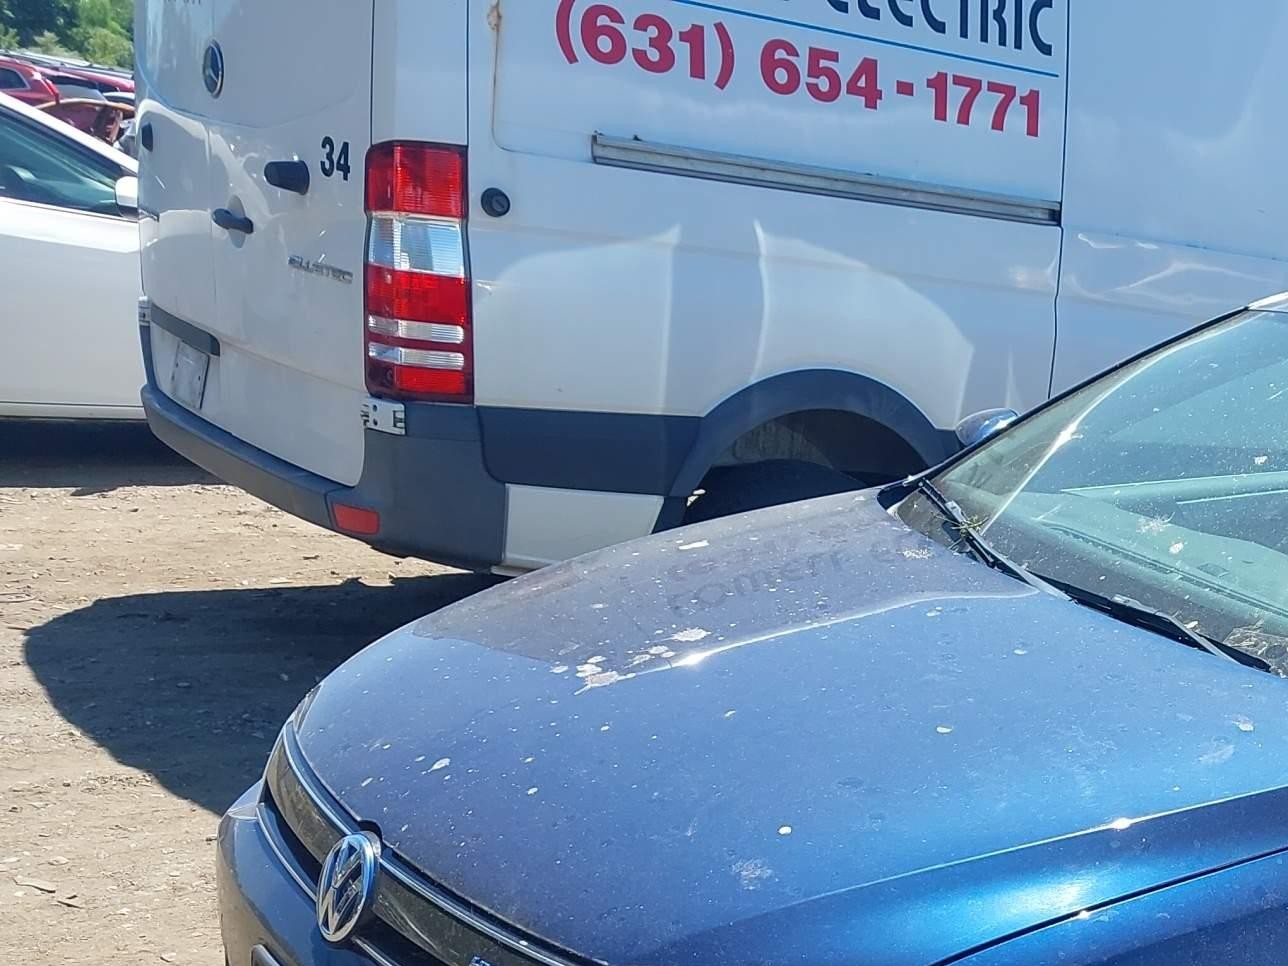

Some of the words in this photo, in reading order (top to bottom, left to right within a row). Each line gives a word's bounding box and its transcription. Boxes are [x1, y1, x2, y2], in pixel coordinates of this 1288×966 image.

[826, 0, 1053, 56] CTRIC
[556, 0, 735, 90] (631)
[760, 39, 1040, 137] 654-1771
[320, 136, 351, 181] 34
